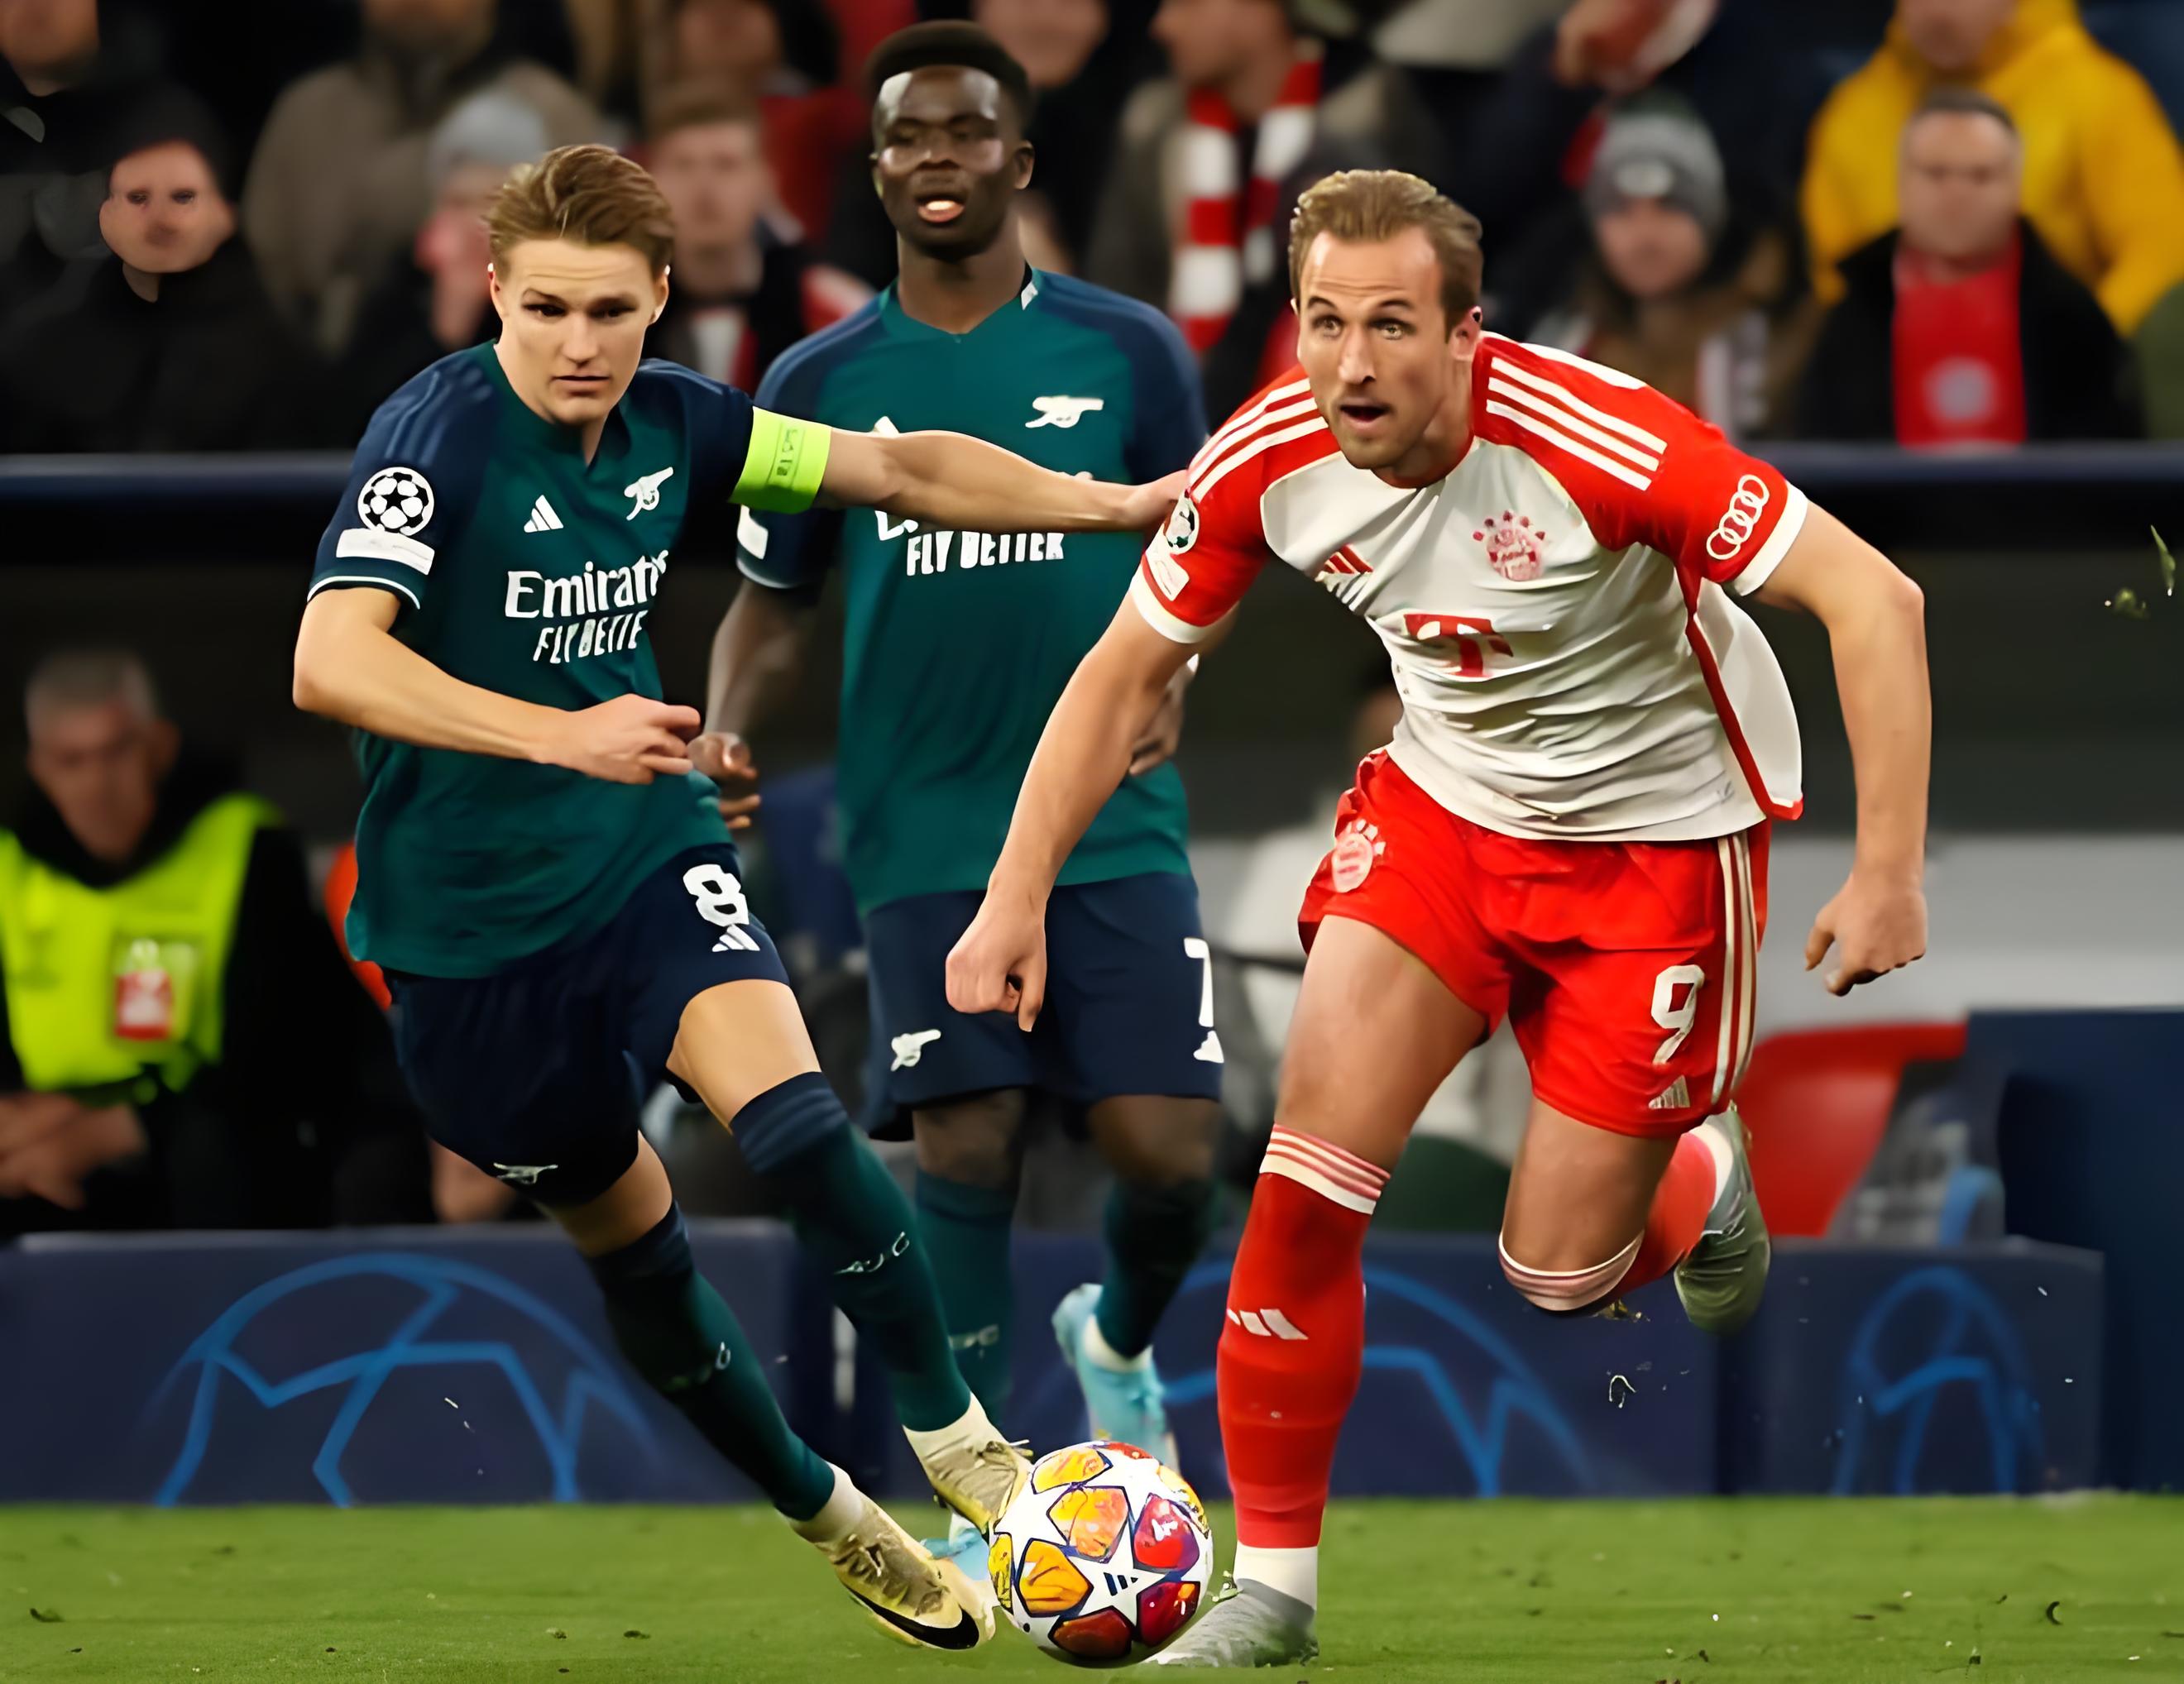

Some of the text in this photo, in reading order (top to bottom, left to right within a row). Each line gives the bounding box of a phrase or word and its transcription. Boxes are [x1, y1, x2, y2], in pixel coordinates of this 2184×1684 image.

[578, 610, 649, 658] BETTE
[682, 864, 750, 927] 8
[1651, 964, 1704, 1064] 9
